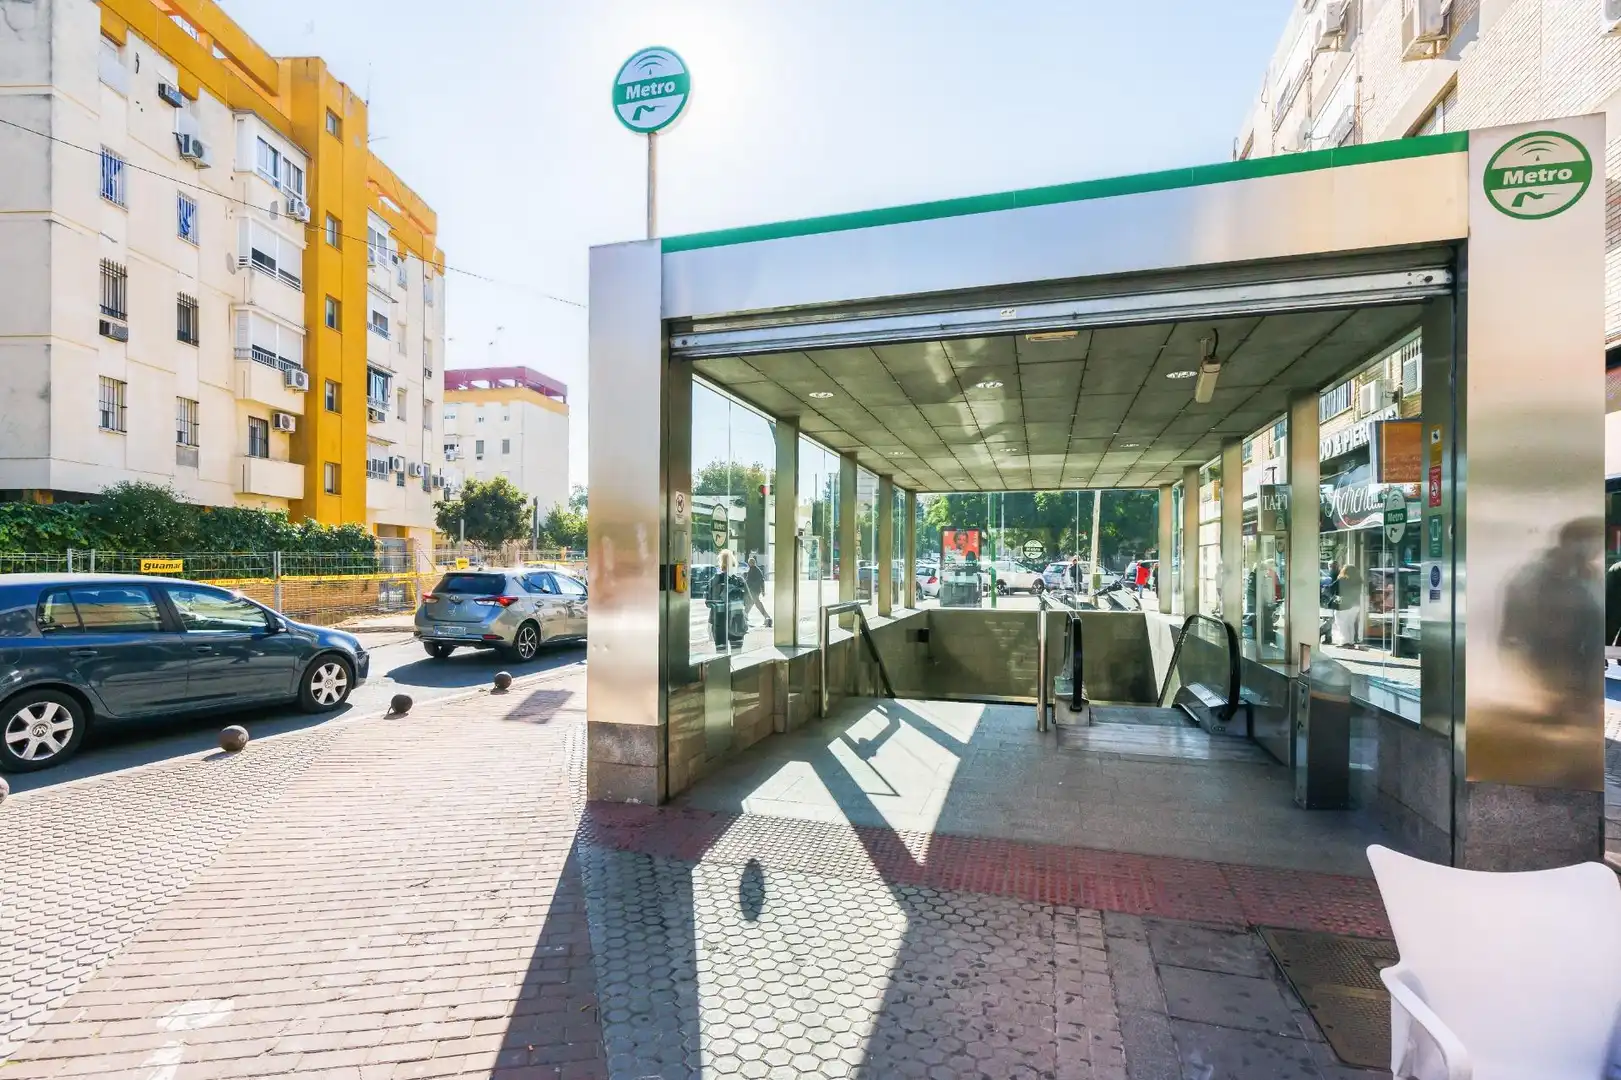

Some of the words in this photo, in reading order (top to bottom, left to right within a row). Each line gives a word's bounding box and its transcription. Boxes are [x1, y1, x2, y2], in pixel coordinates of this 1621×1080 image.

[625, 81, 676, 101] Metro
[1502, 168, 1573, 186] Metro
[1387, 512, 1404, 524] Metro
